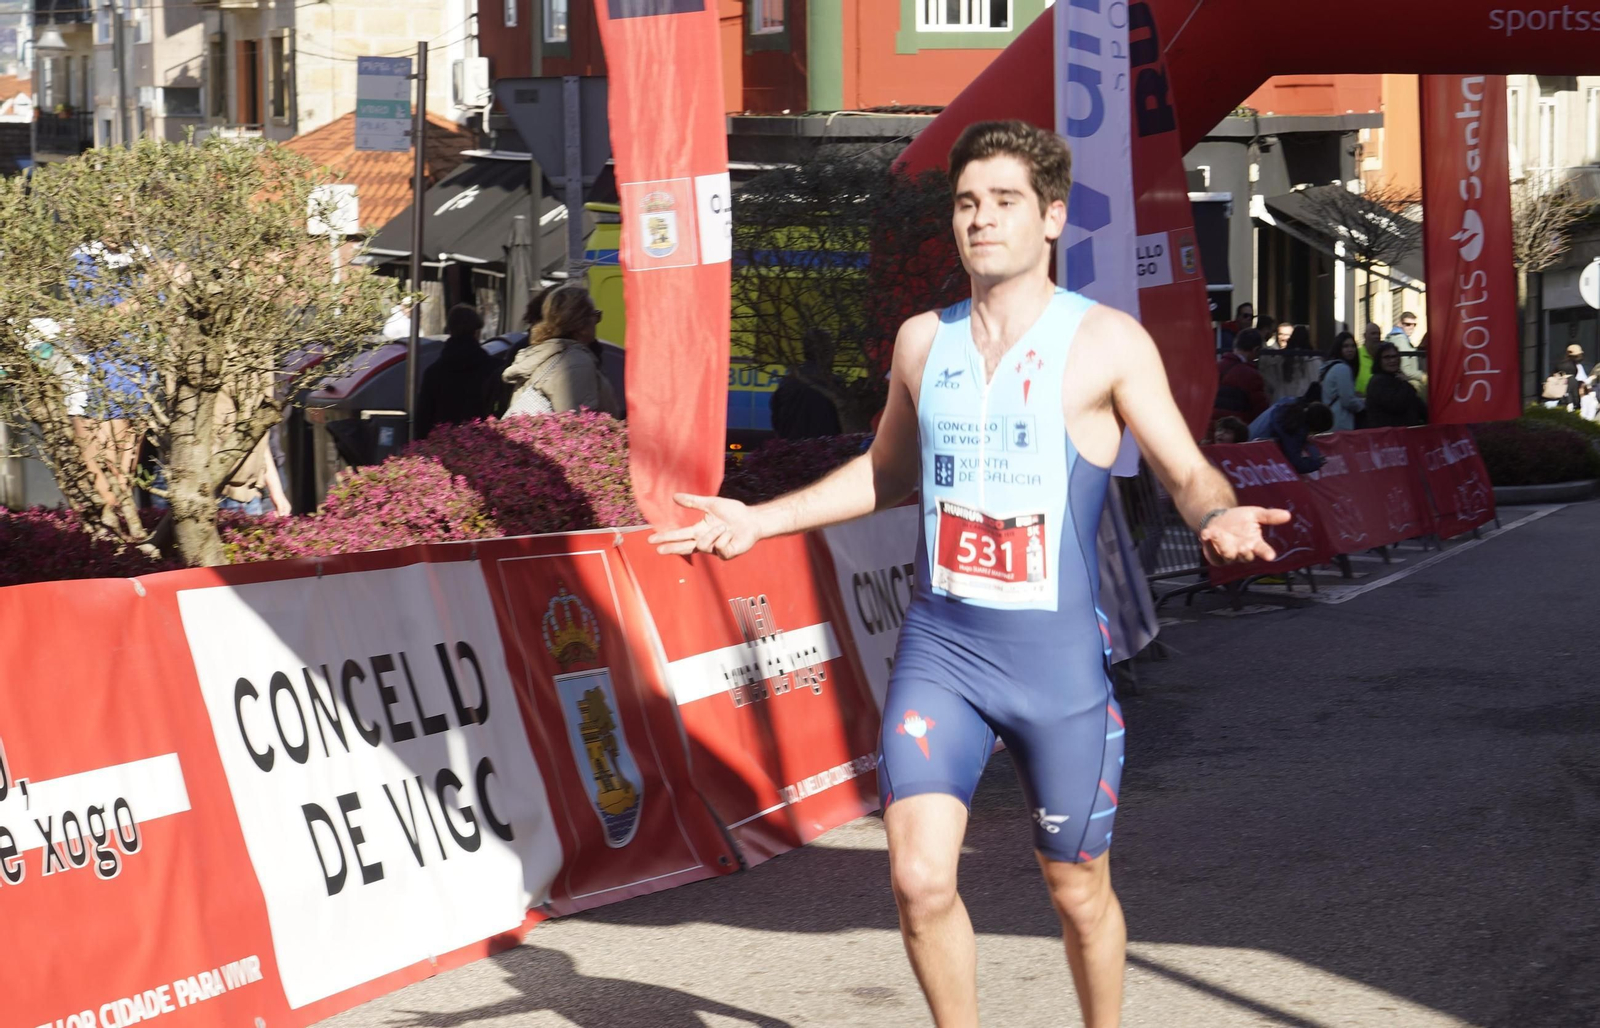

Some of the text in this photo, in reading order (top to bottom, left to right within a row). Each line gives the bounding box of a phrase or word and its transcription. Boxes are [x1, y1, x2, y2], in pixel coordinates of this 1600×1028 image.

[1453, 269, 1501, 402] Sports
[937, 420, 998, 432] CONCELLO
[943, 434, 991, 446] DE VIGO
[959, 470, 1042, 486] DE GALICIA
[960, 458, 1009, 470] XUNTA
[957, 531, 1013, 573] 531
[33, 797, 142, 880] xogo
[301, 791, 385, 897] DE
[99, 983, 176, 1028] CIDADE
[173, 970, 227, 1008] PARA
